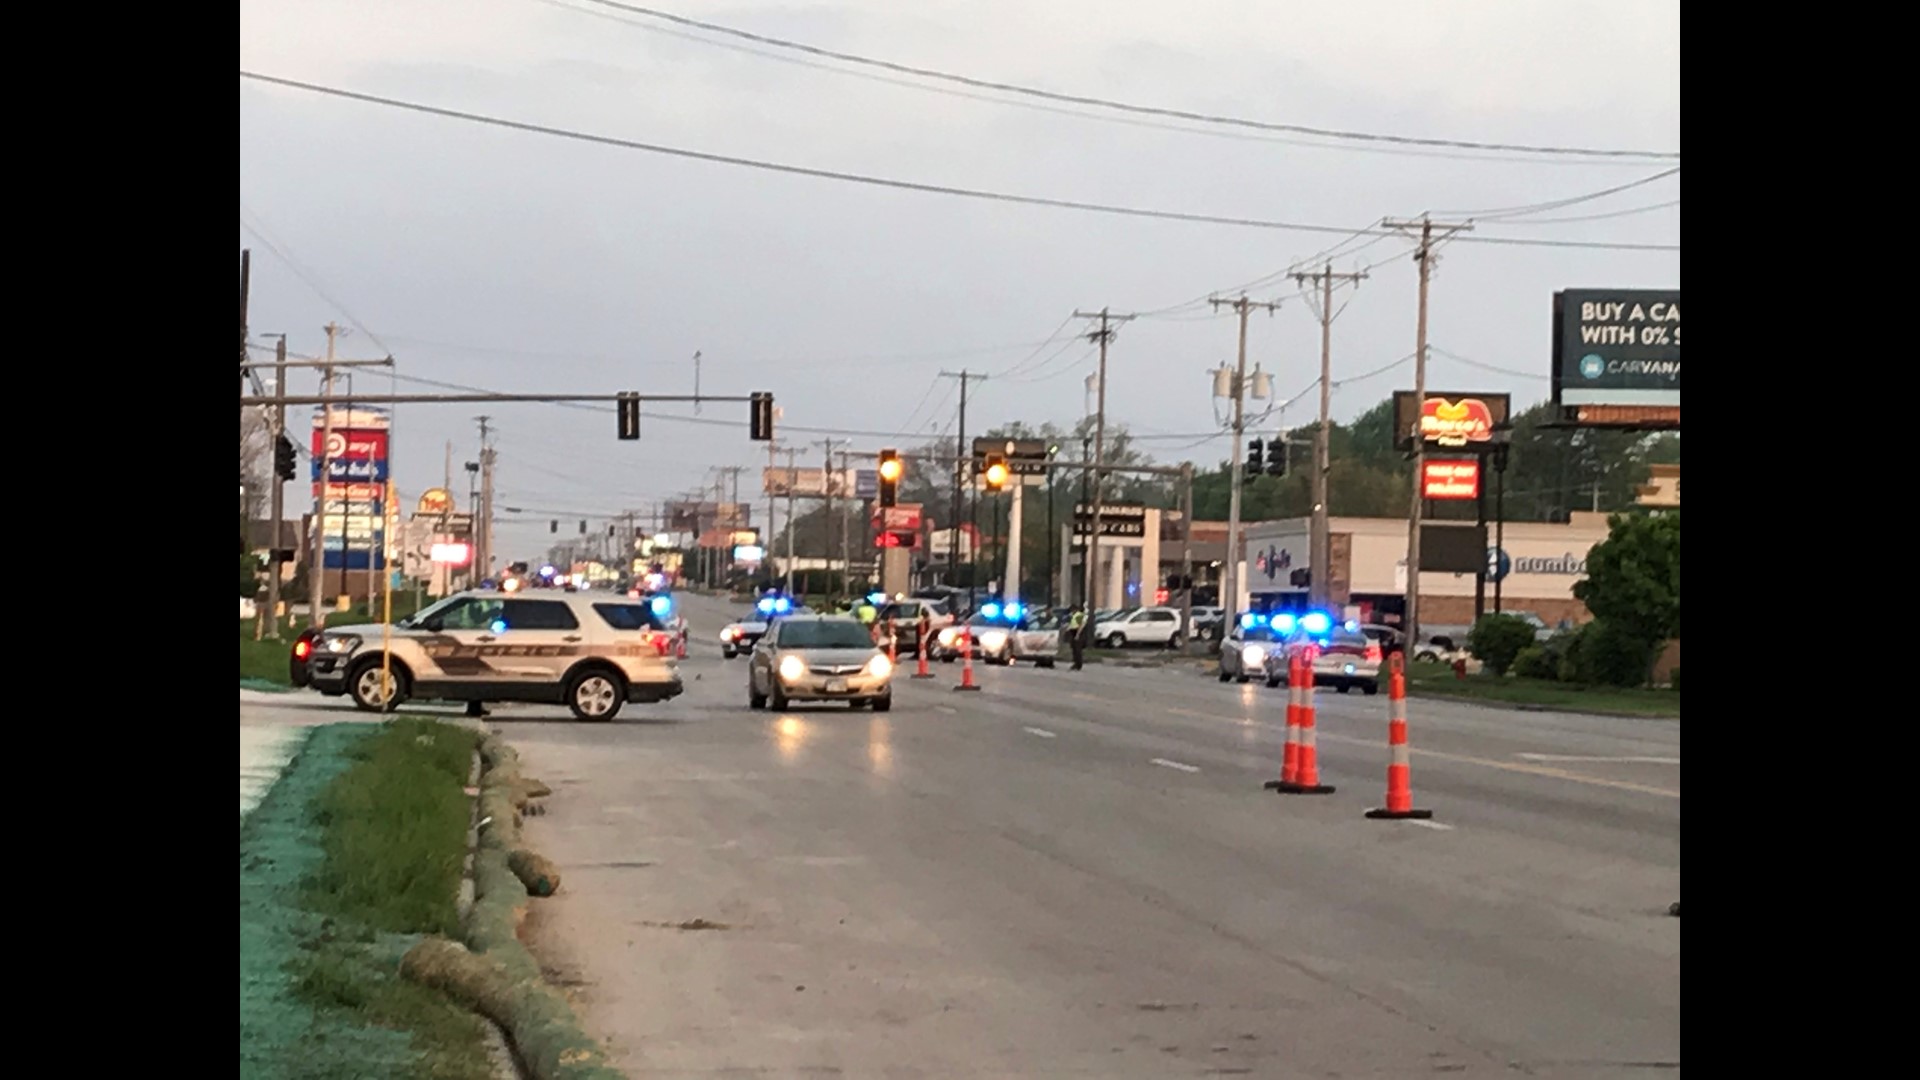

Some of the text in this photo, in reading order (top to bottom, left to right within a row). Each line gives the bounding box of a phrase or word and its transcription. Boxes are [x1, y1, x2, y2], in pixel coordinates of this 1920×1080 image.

[1581, 302, 1625, 321] BUY
[1628, 303, 1645, 321] A
[1581, 325, 1635, 344] WITH
[1641, 327, 1670, 345] 0%
